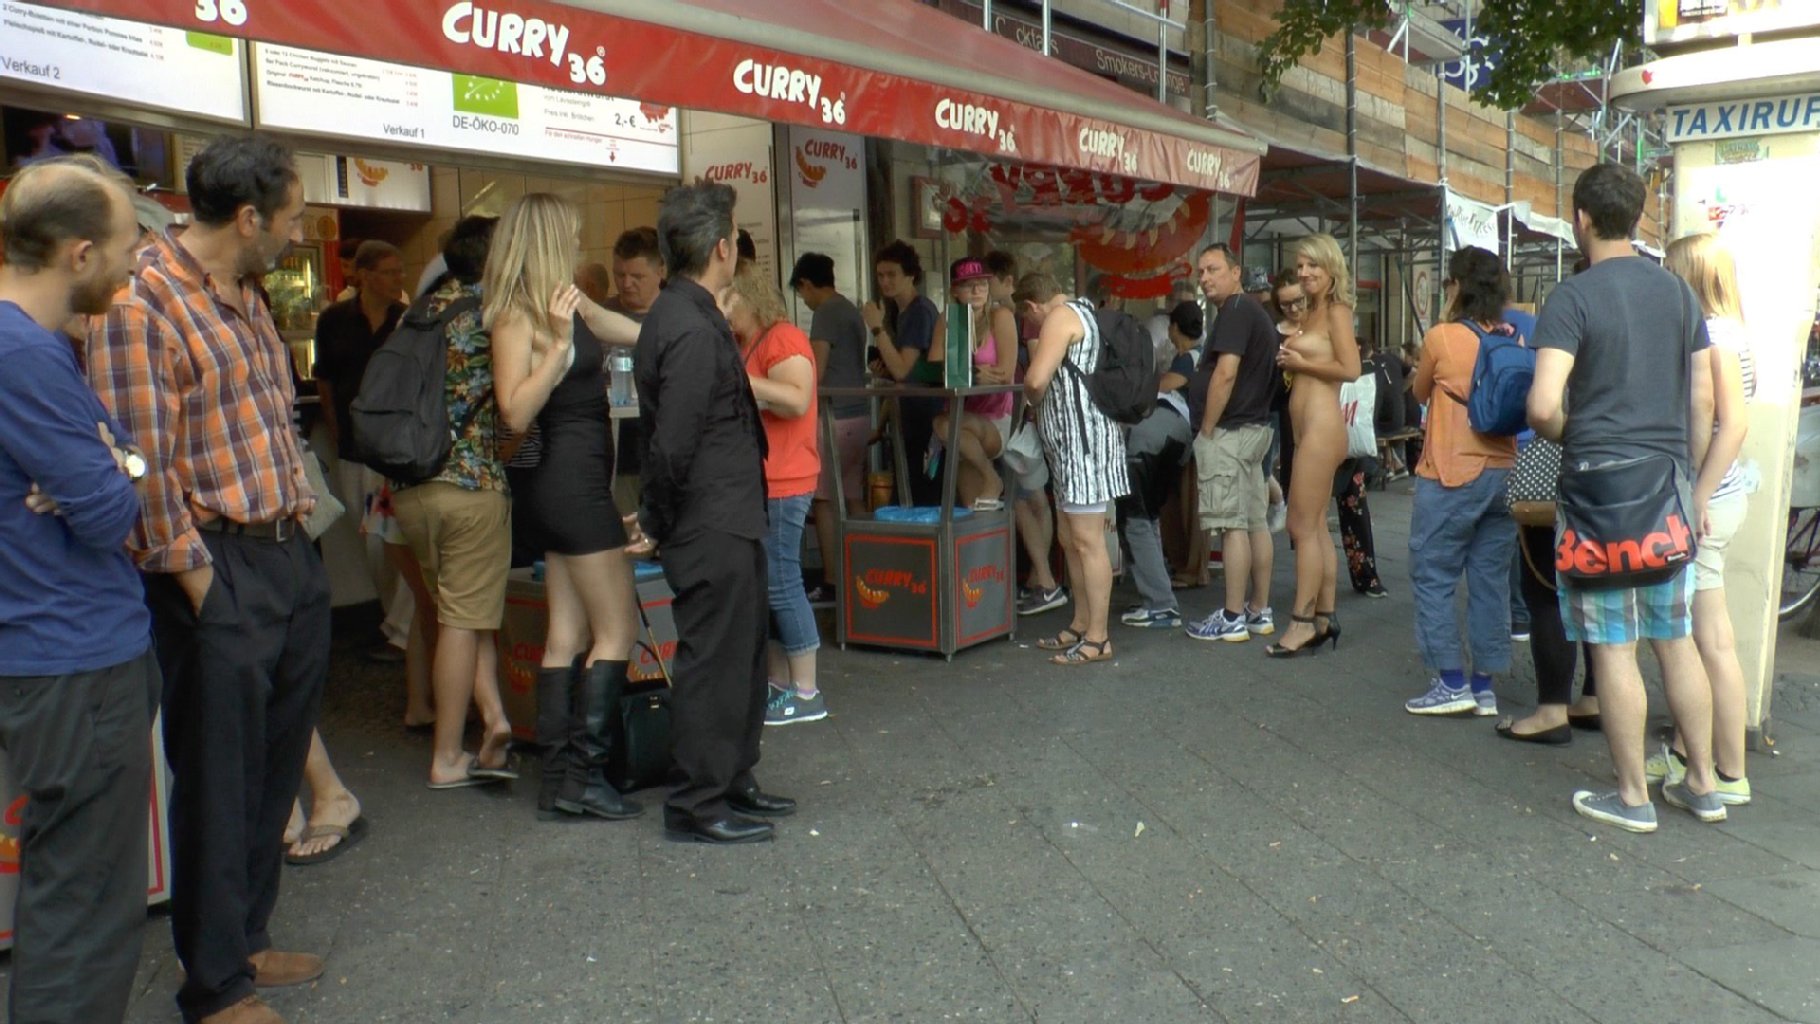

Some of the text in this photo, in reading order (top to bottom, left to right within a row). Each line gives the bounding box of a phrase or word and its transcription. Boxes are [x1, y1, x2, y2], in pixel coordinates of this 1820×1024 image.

[442, 2, 606, 86] CURRY 36
[995, 16, 1059, 55] Ccktas
[1, 56, 61, 79] Verkauf 2
[1096, 48, 1185, 95] Smokers-Longe
[733, 59, 846, 125] CURRY 36
[383, 124, 425, 138] Verkauf 1
[452, 115, 519, 136] DE-ÖKO-070
[935, 98, 1017, 153] CURRY 36
[1673, 96, 1820, 137] TAXIRUF
[805, 139, 857, 170] CURRY 36
[1079, 127, 1137, 174] CURRY 36
[1187, 148, 1222, 178] CURRY
[705, 162, 767, 184] CURRY 36
